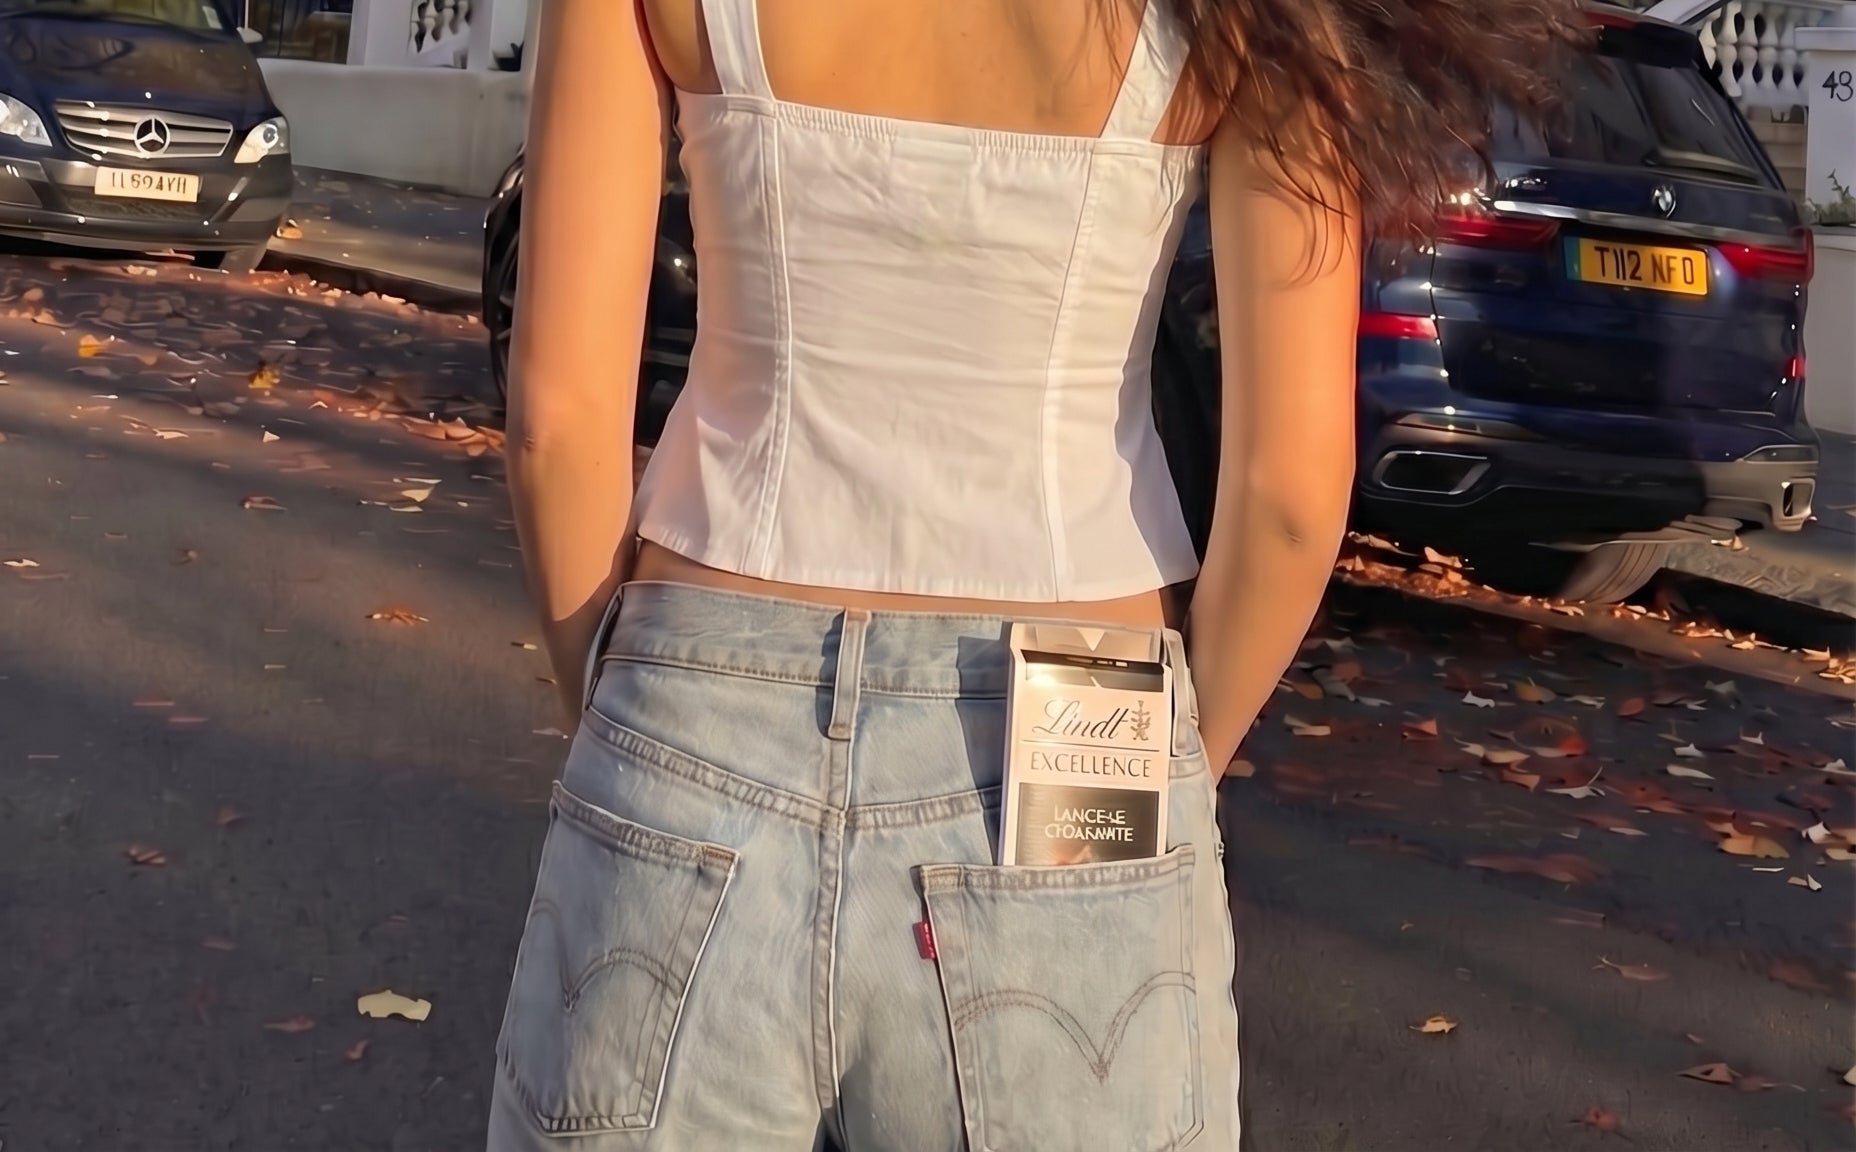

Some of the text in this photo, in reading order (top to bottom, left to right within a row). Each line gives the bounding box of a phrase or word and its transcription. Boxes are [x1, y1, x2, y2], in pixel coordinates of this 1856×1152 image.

[1594, 246, 1642, 281] T112
[1031, 699, 1130, 740] Lindt
[1030, 751, 1151, 778] EXCELLENCE
